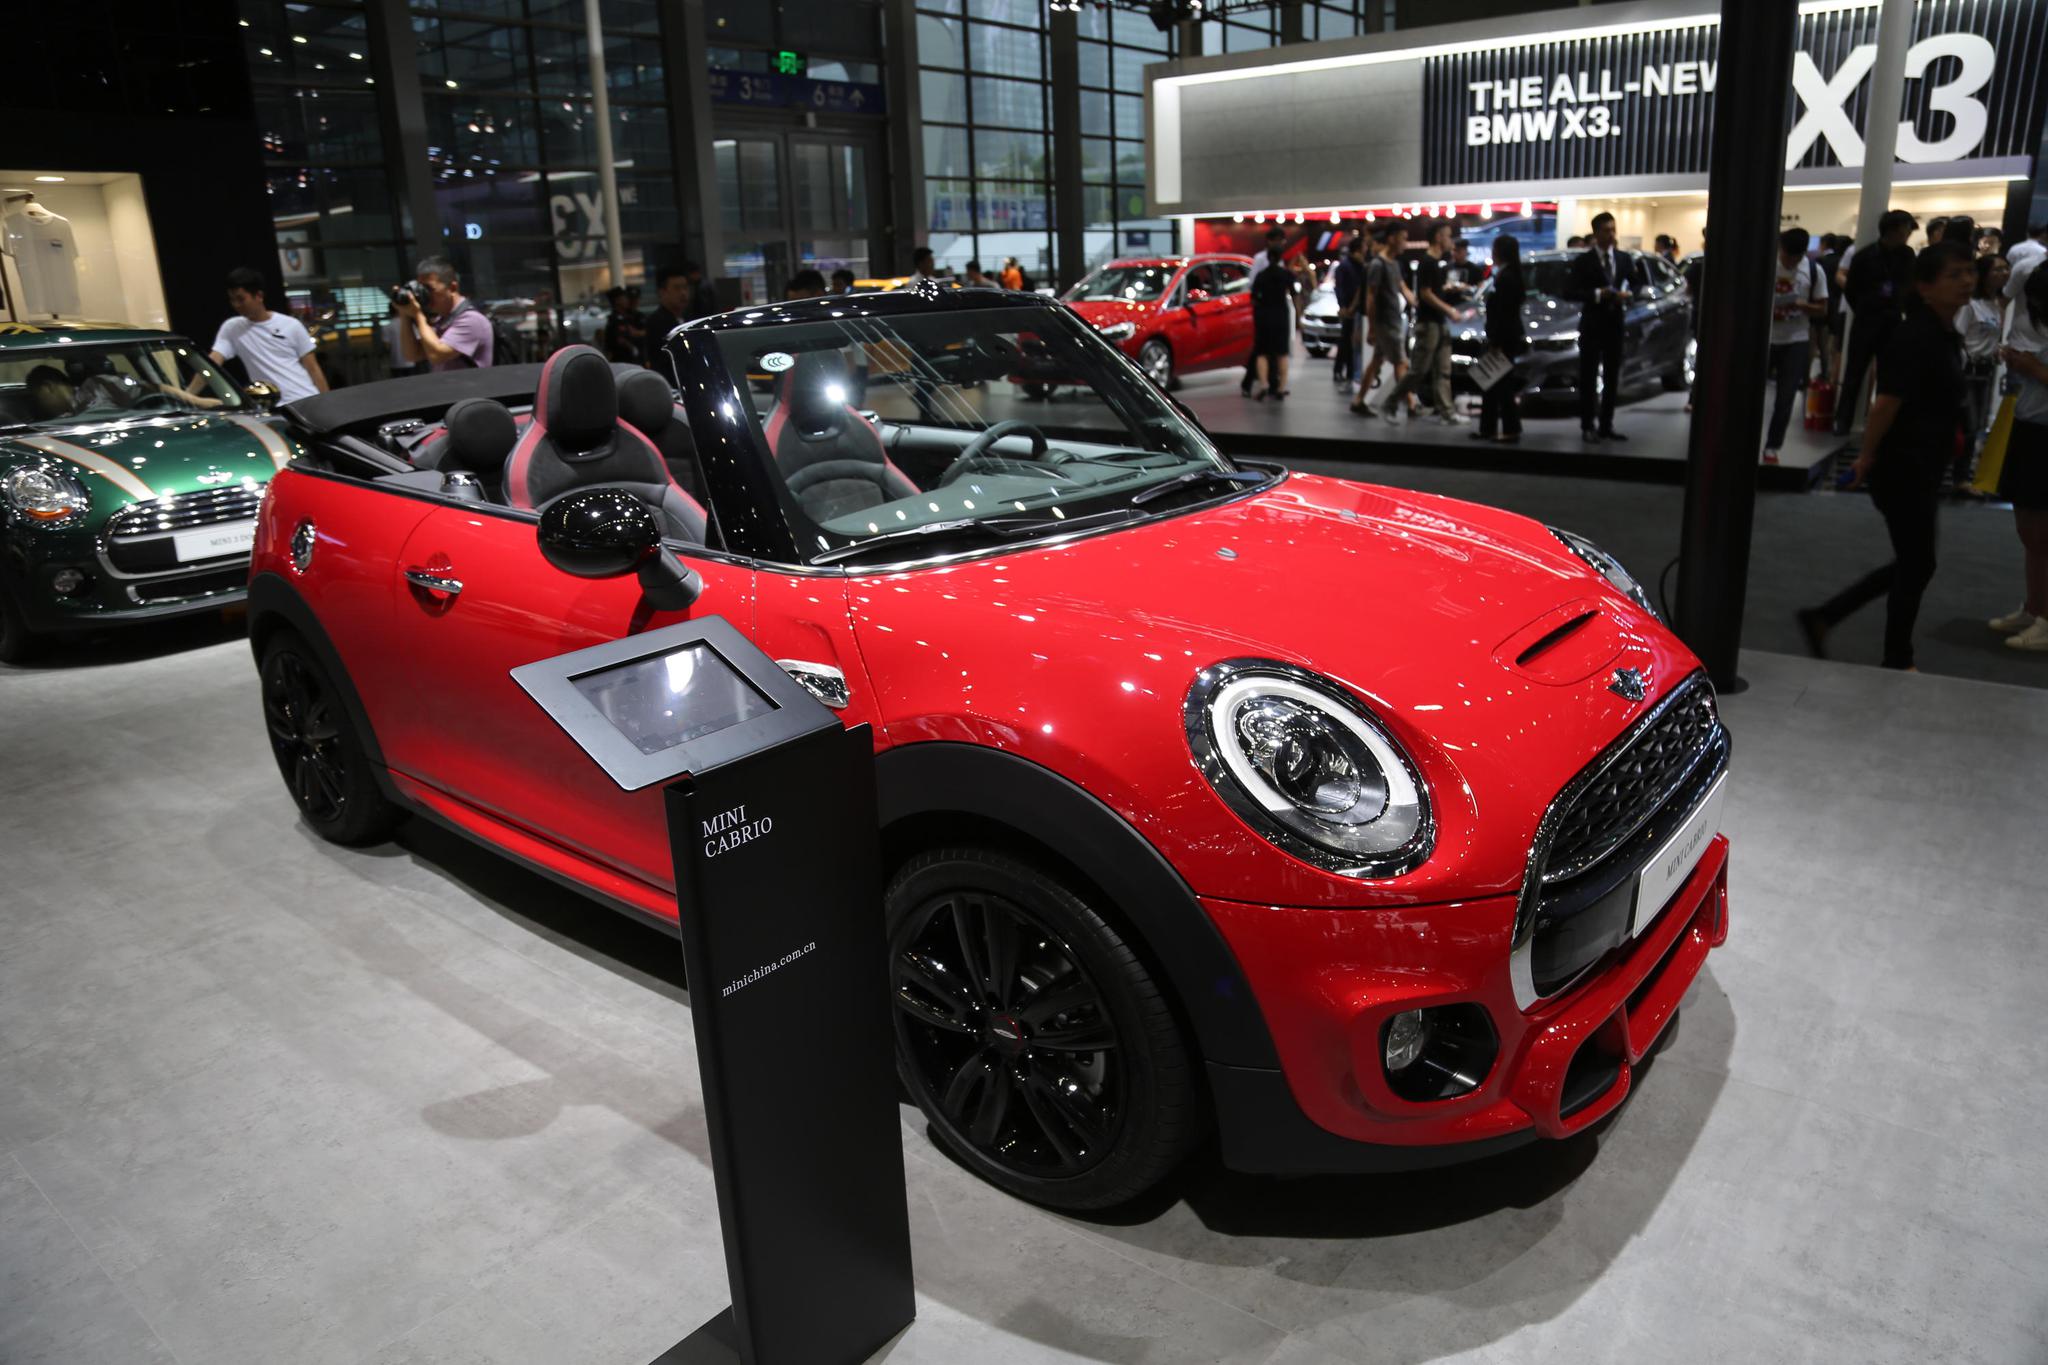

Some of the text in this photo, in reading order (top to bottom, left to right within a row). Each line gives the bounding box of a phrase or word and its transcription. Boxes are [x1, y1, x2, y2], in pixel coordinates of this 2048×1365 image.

[1468, 76, 1543, 111] THE
[1785, 32, 1996, 171] X3
[1466, 105, 1621, 146] BMW X3.
[701, 804, 747, 838] MINI
[704, 816, 773, 858] CABRIO
[721, 940, 817, 998] minichina.com.cn
